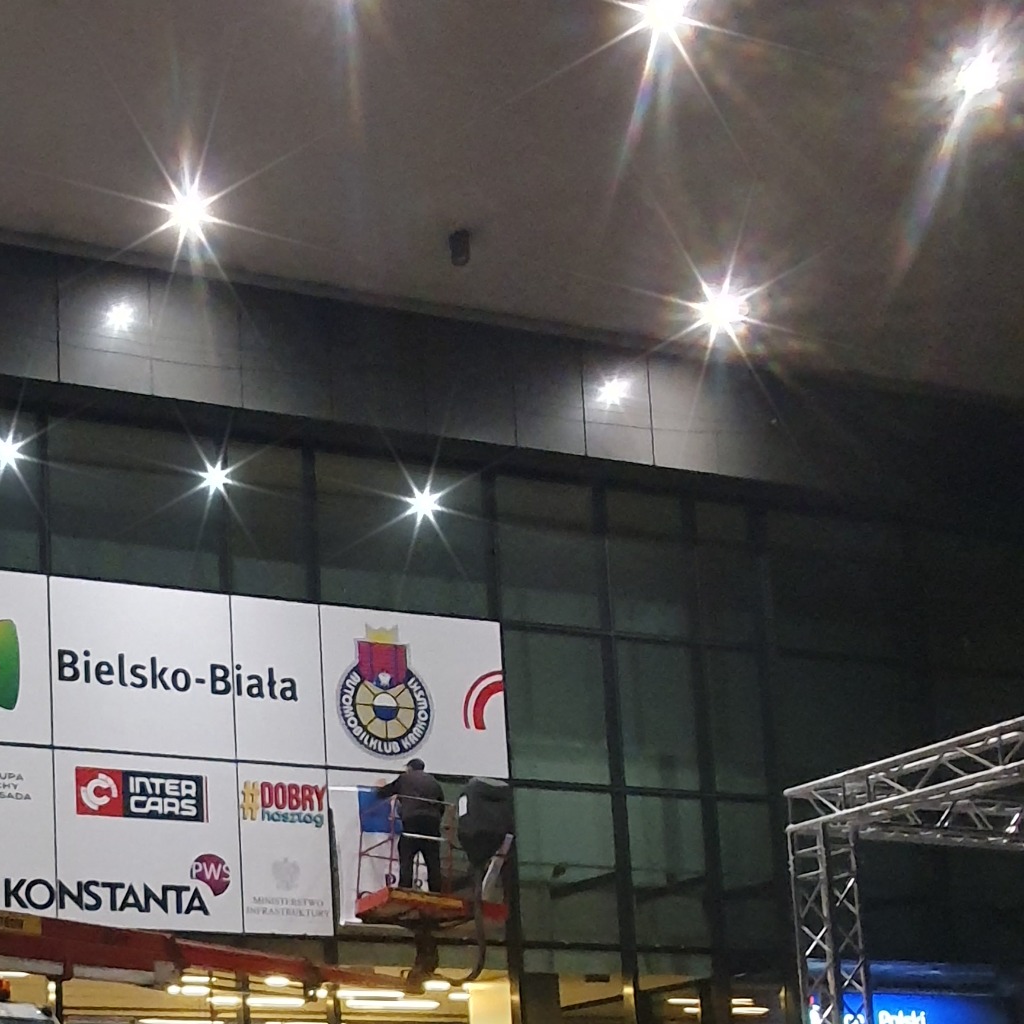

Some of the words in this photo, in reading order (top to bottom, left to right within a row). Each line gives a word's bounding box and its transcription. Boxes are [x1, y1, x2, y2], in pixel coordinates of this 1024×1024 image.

[57, 648, 298, 702] Bielsko-Biała
[129, 776, 197, 798] INTER
[129, 798, 198, 817] CARS
[193, 862, 230, 881] PWS
[3, 878, 211, 916] KONSTANTA
